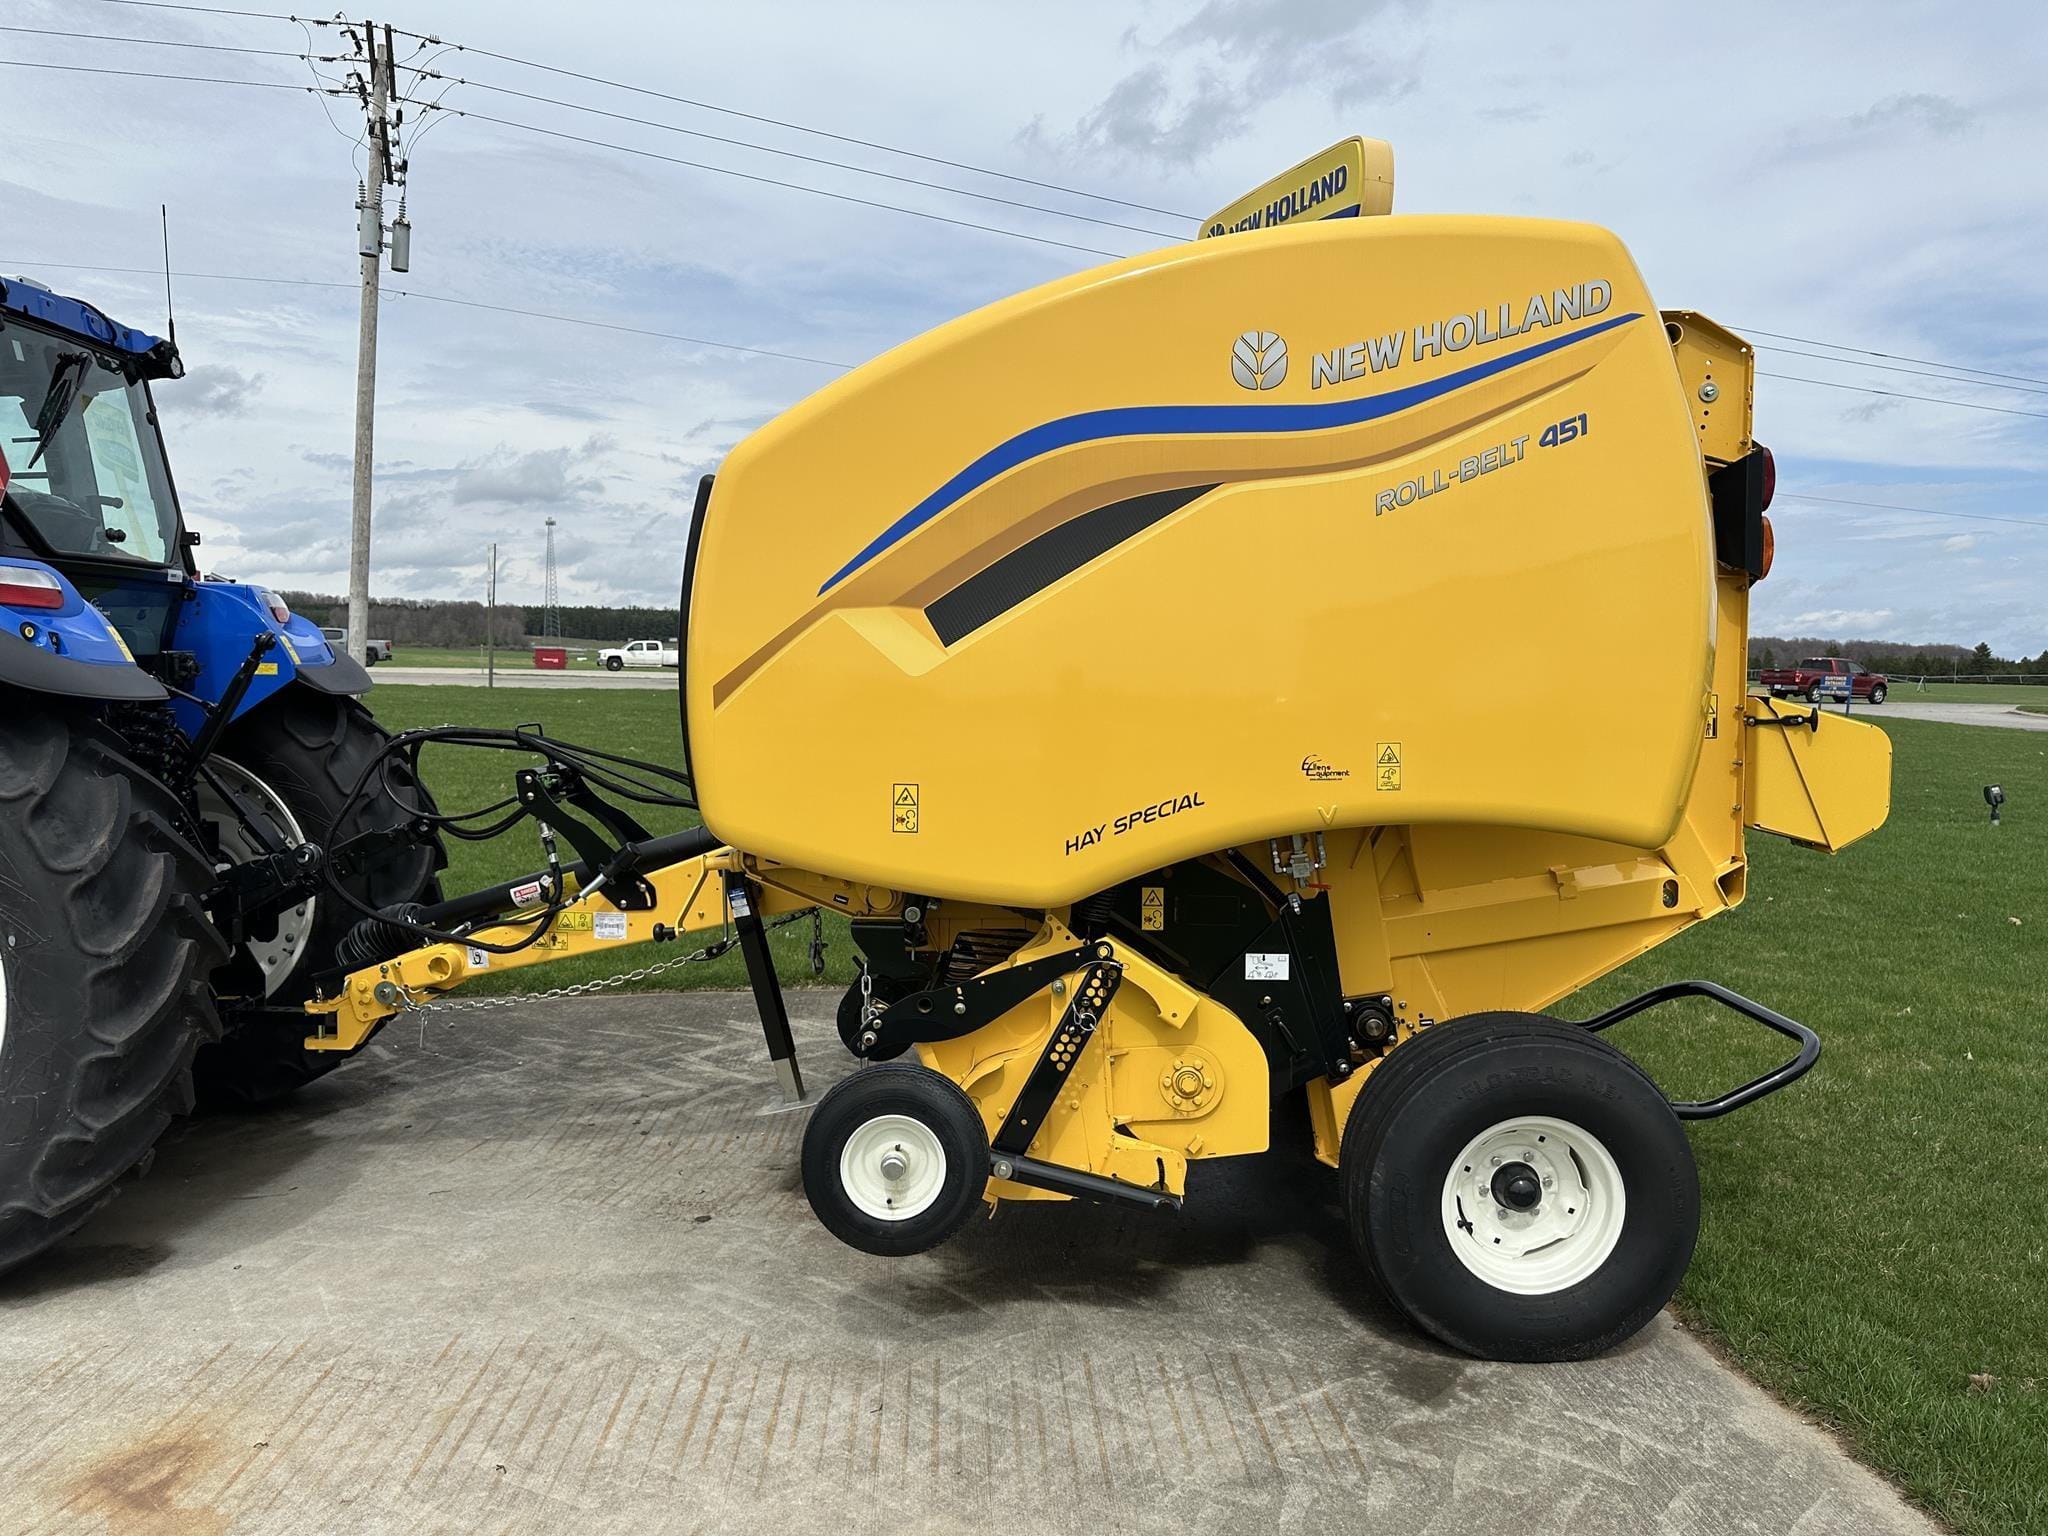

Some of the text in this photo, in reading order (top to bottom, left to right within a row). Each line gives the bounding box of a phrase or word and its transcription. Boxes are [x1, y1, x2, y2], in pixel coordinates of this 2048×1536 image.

[1265, 165, 1348, 228] HOLLAND
[1312, 279, 1612, 390] NEW HOLLAND
[1375, 412, 1588, 517] ROLL-BELT 451
[1065, 791, 1205, 856] HAY SPECIAL
